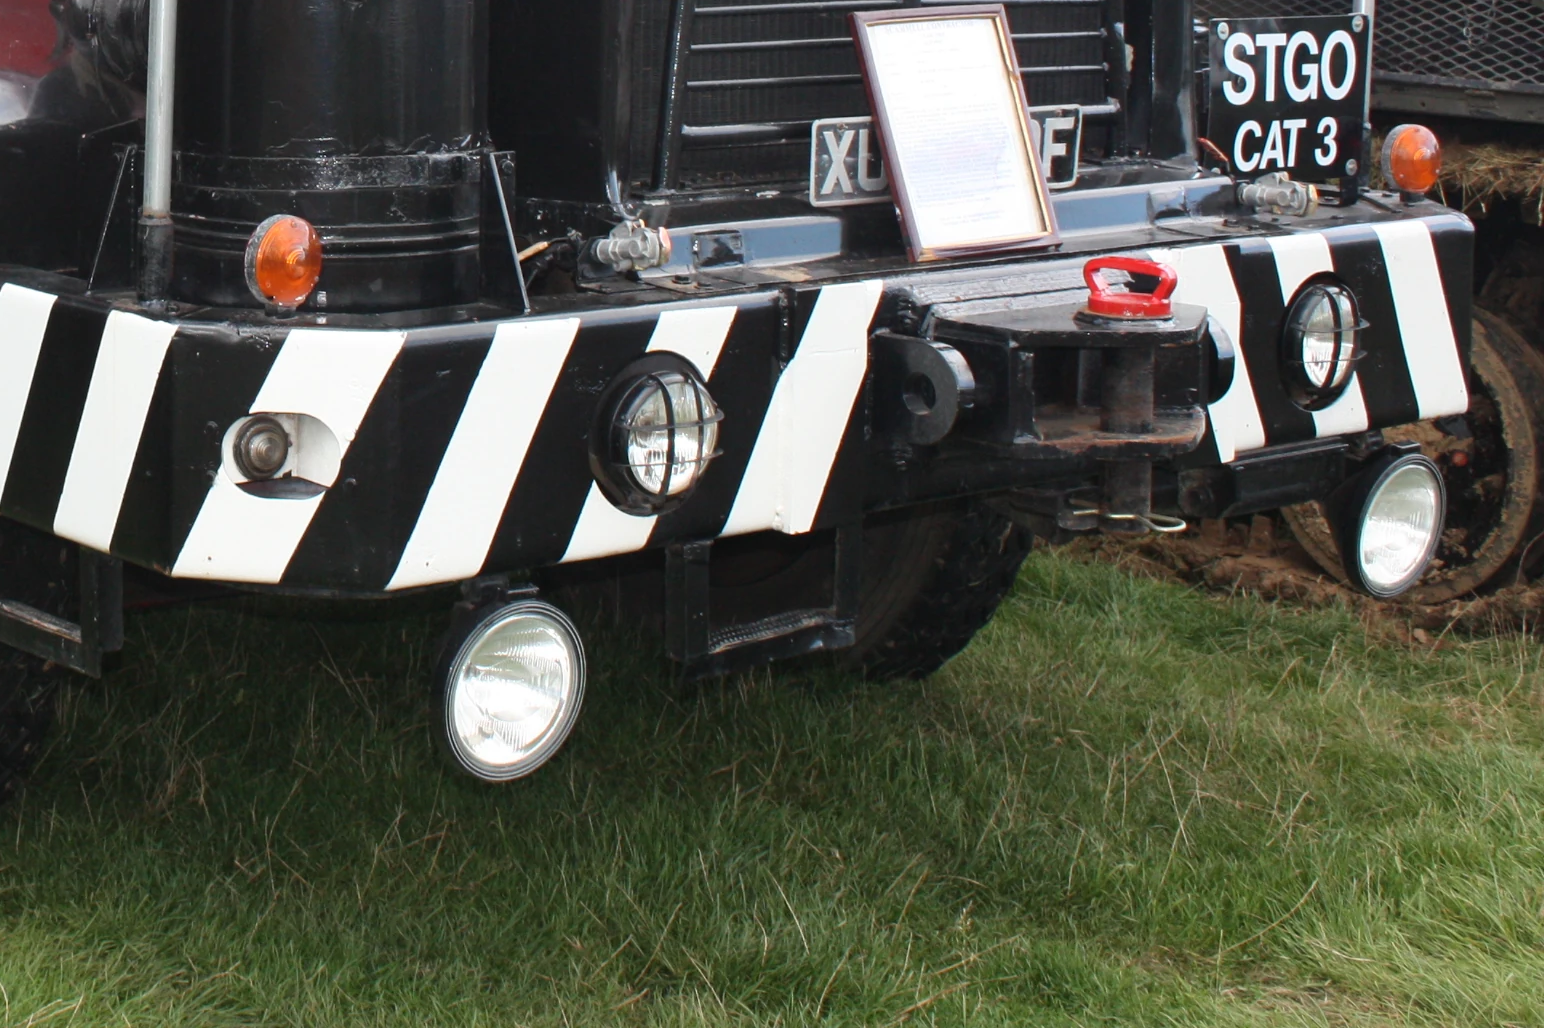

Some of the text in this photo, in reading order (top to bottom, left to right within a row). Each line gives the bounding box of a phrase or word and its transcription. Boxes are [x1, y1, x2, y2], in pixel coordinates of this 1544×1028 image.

[1222, 30, 1357, 106] STGO
[1233, 116, 1338, 172] CAT 3
